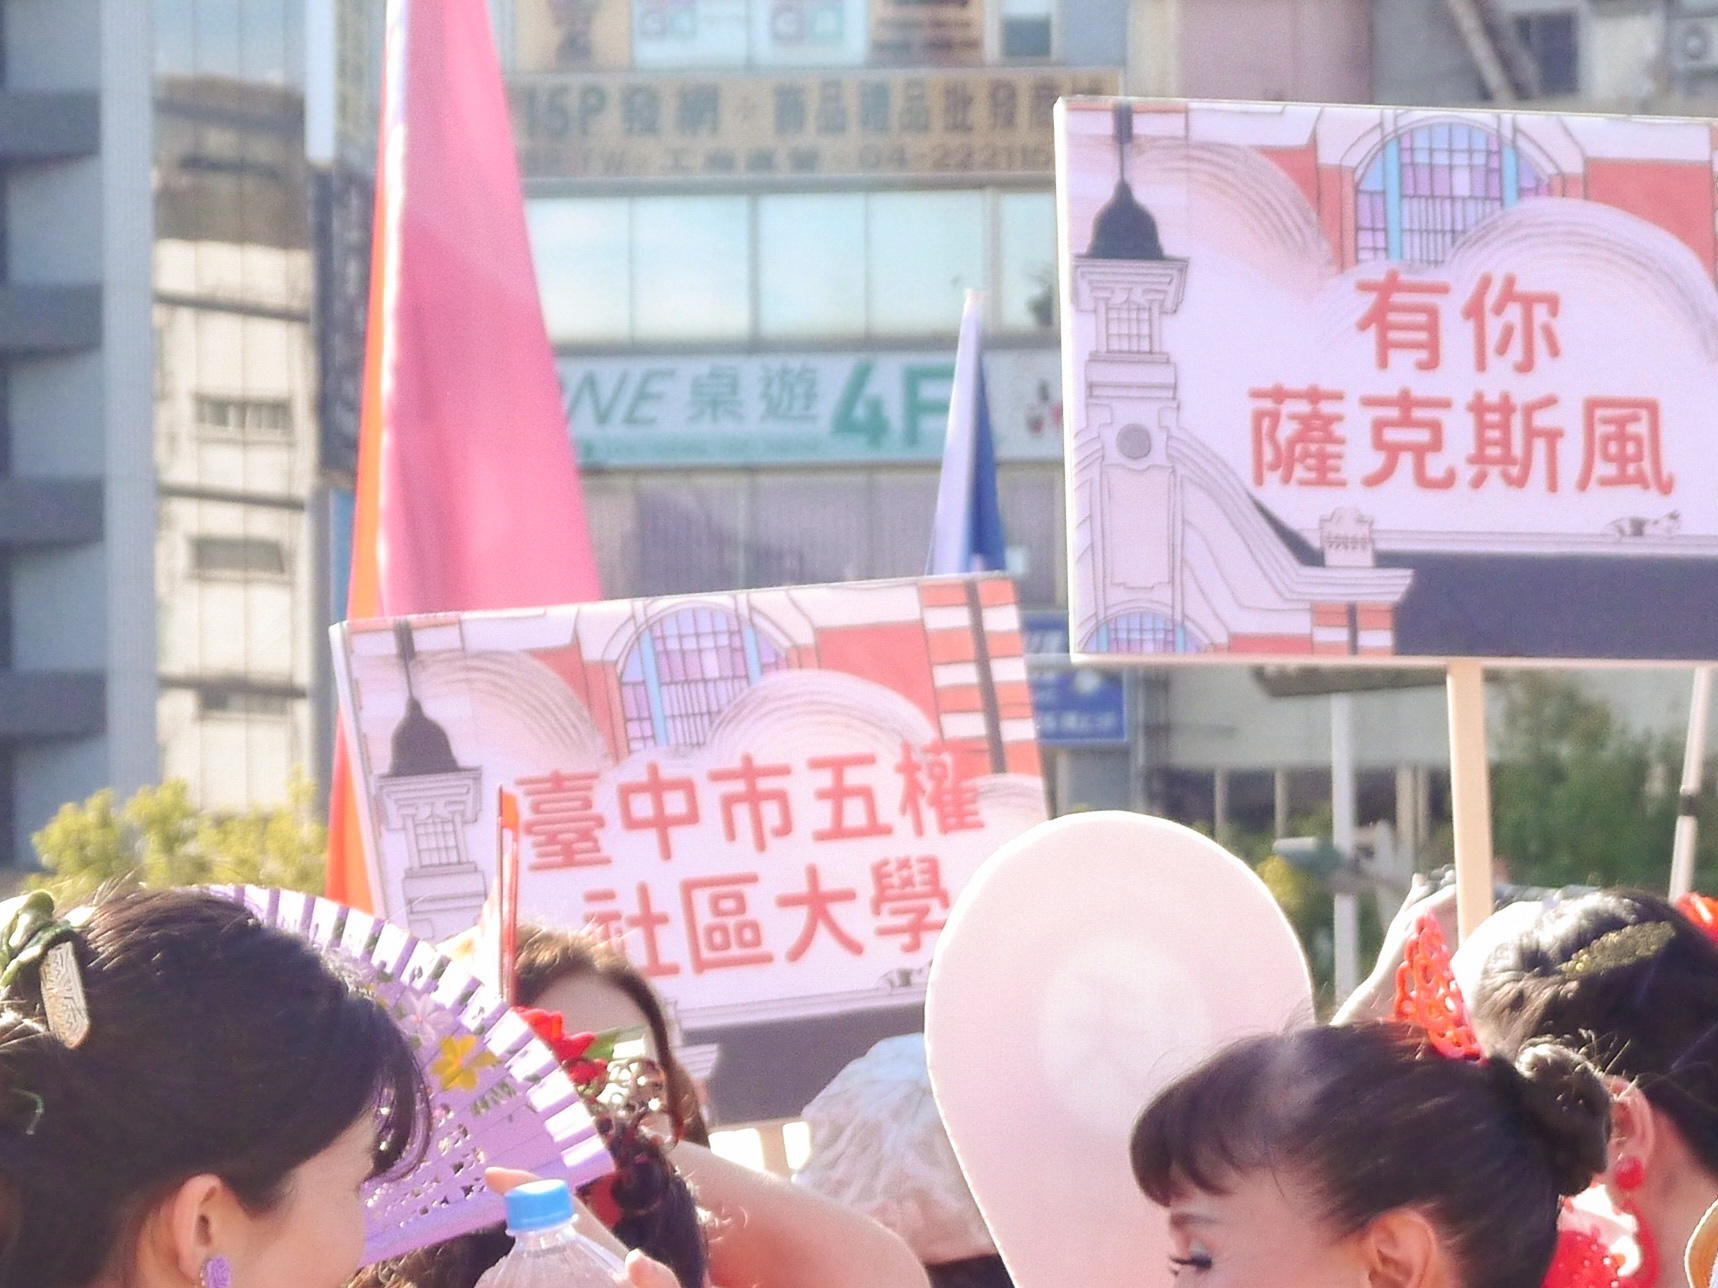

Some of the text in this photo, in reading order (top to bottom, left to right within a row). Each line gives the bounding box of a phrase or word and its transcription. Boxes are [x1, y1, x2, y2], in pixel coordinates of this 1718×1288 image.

[1356, 270, 1561, 373] 有你
[688, 363, 822, 425] 桌遊
[829, 359, 957, 452] 4F
[1250, 384, 1674, 496] 薩克斯風
[514, 742, 985, 871] 臺中市五權
[583, 853, 950, 979] 社區大學
